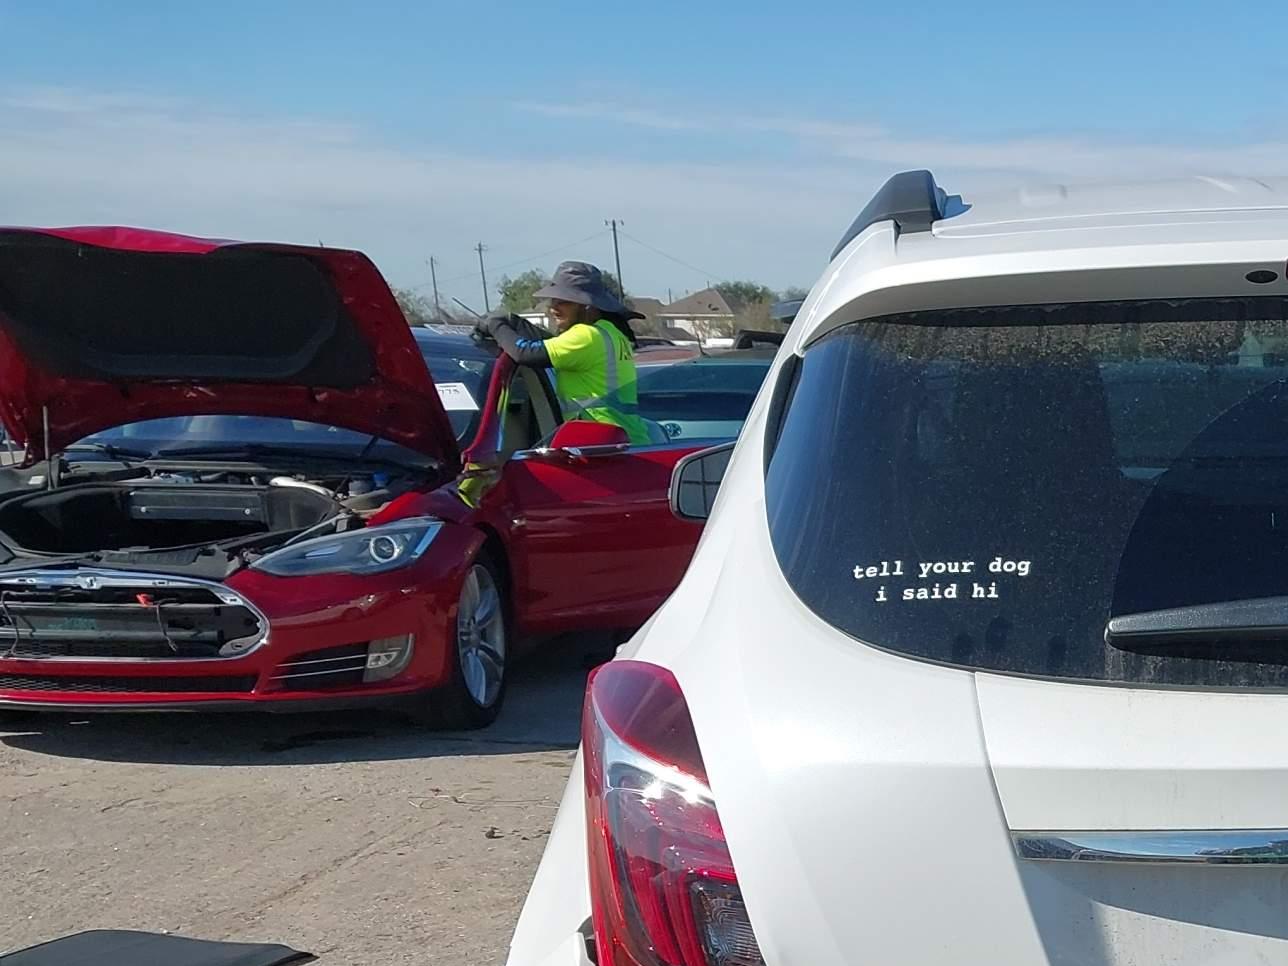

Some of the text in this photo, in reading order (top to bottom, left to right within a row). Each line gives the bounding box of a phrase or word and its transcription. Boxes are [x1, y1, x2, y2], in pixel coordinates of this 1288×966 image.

[853, 557, 1031, 579] tell your dog
[875, 582, 999, 602] i said hi
